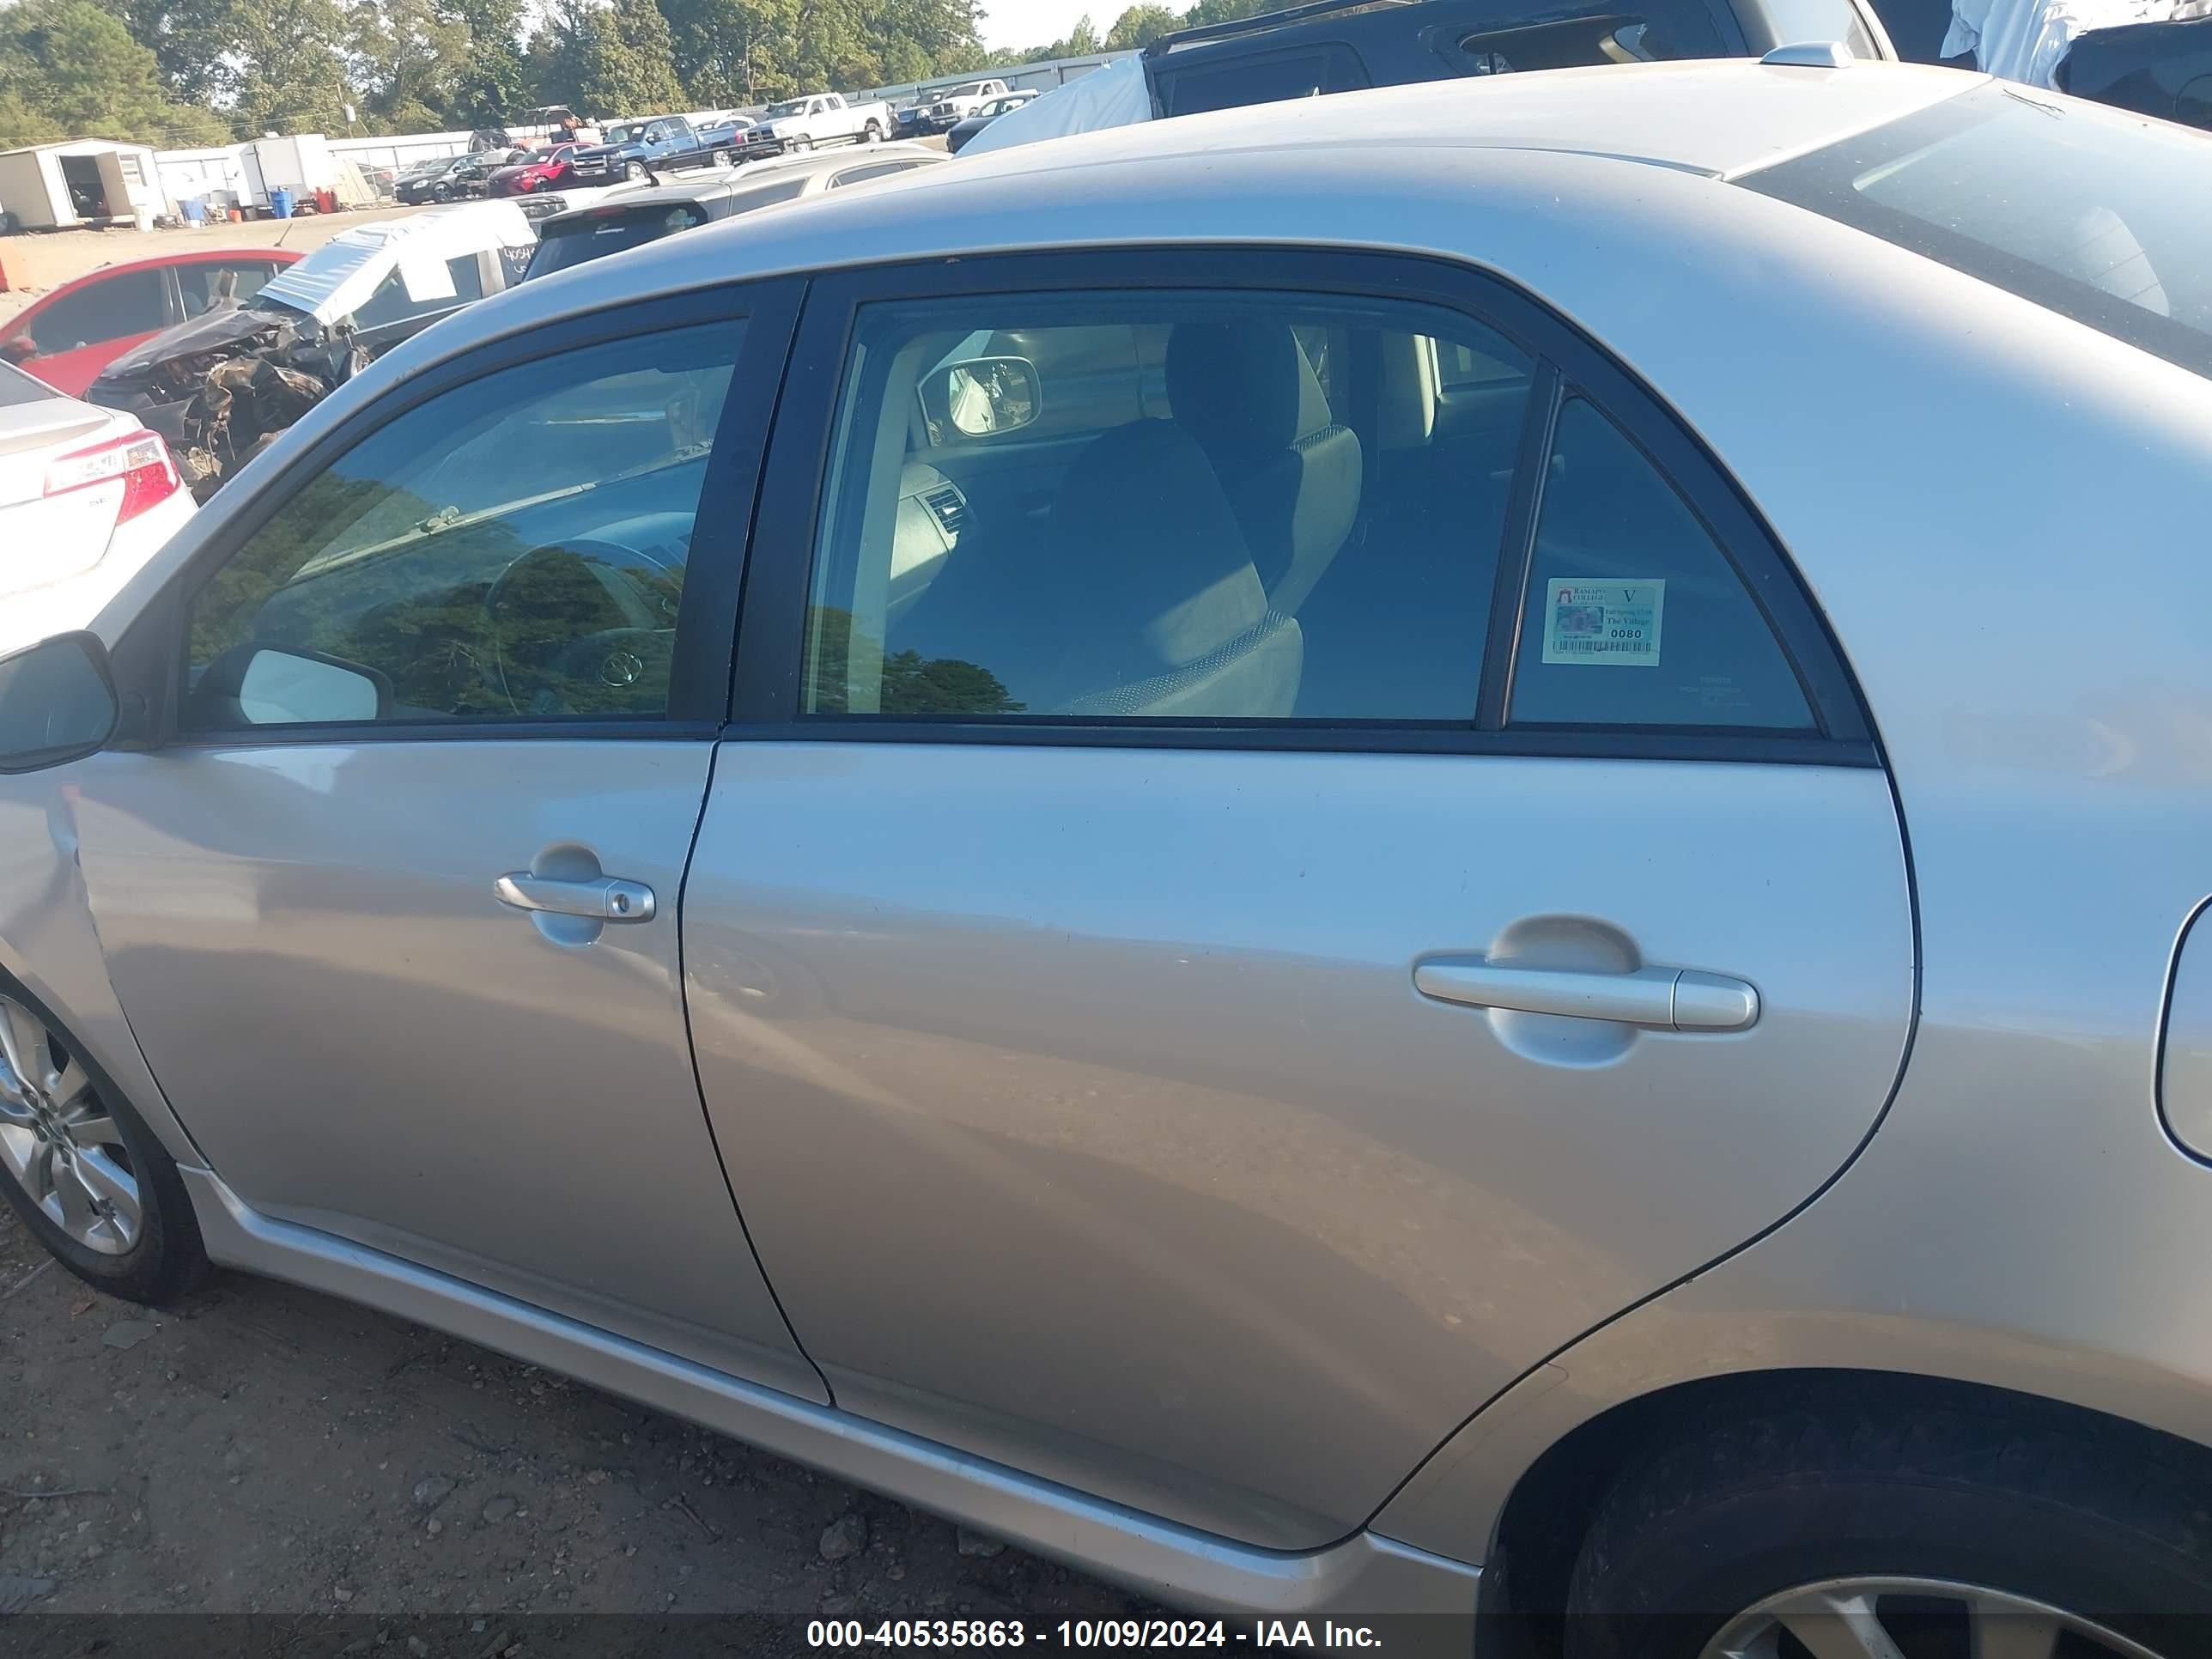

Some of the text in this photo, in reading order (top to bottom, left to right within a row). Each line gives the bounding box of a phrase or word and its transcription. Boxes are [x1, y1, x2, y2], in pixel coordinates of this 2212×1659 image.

[1623, 589, 1637, 602] V
[1624, 617, 1650, 626] Village
[1611, 629, 1642, 638] 0080
